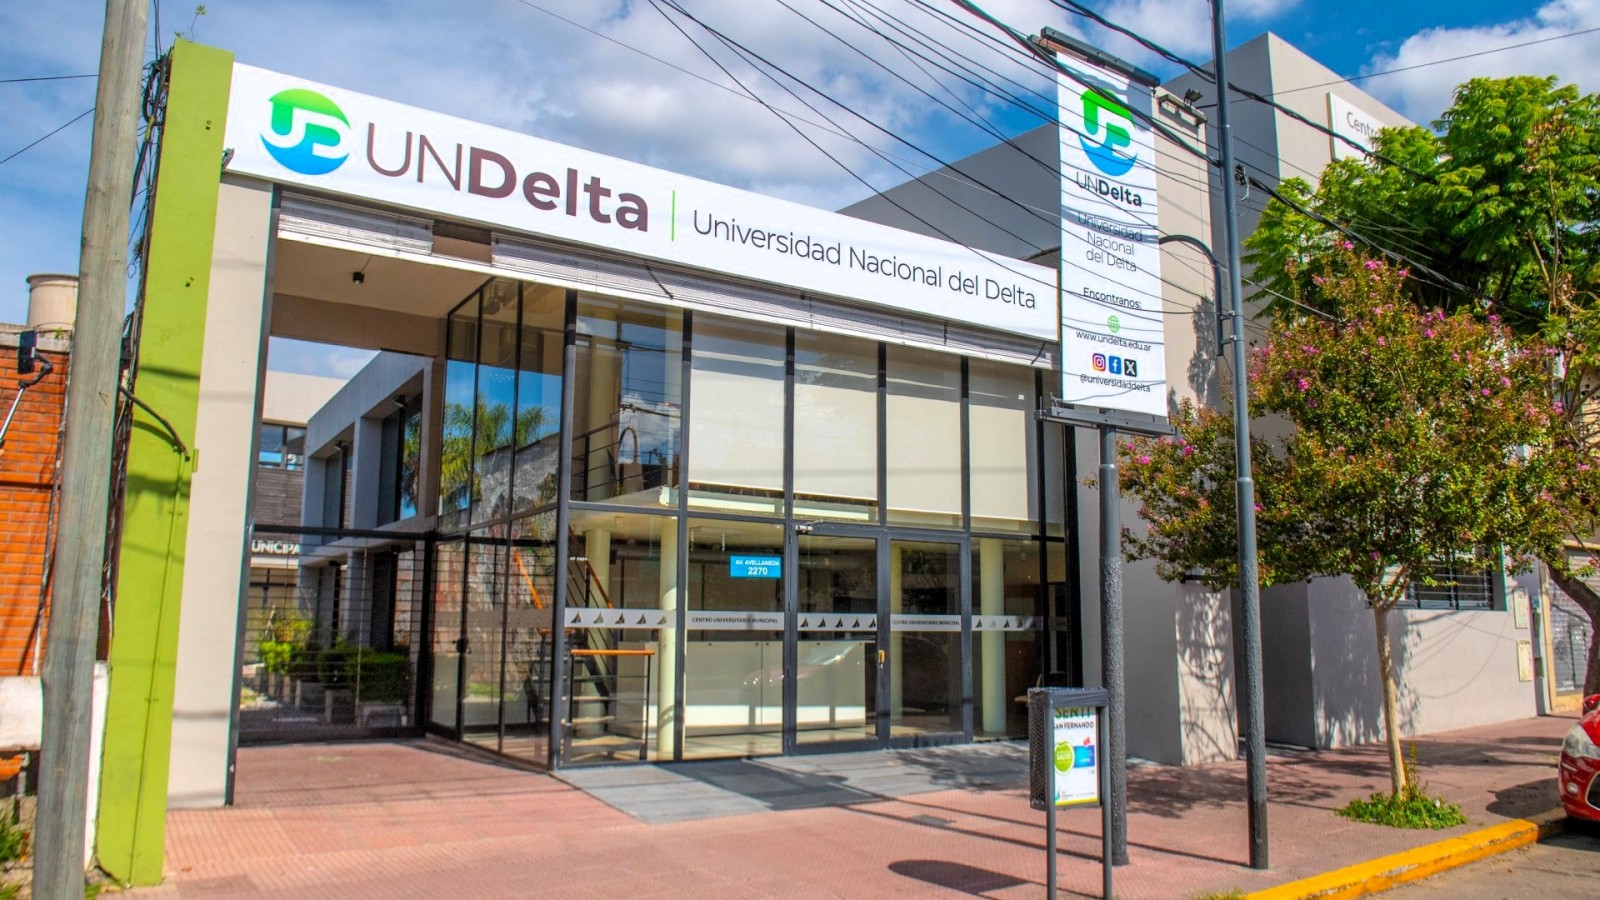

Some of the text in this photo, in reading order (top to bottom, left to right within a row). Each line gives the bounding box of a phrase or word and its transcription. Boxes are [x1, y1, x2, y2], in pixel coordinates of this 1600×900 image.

[366, 121, 649, 233] UNDelta
[1076, 171, 1142, 207] UNDelta
[1077, 211, 1143, 242] Universidad
[1087, 231, 1135, 255] Nacional
[693, 209, 1036, 310] Universidad Nacional del Delta
[1086, 248, 1137, 272] del Delta
[1083, 286, 1142, 309] Encontranos:
[1076, 331, 1151, 351] www.undelta.edu.ar
[1080, 373, 1151, 392] @universidaddelta
[745, 559, 780, 567] AVELLANEDA
[748, 566, 768, 576] 2270
[1064, 721, 1095, 729] FERNANDO
